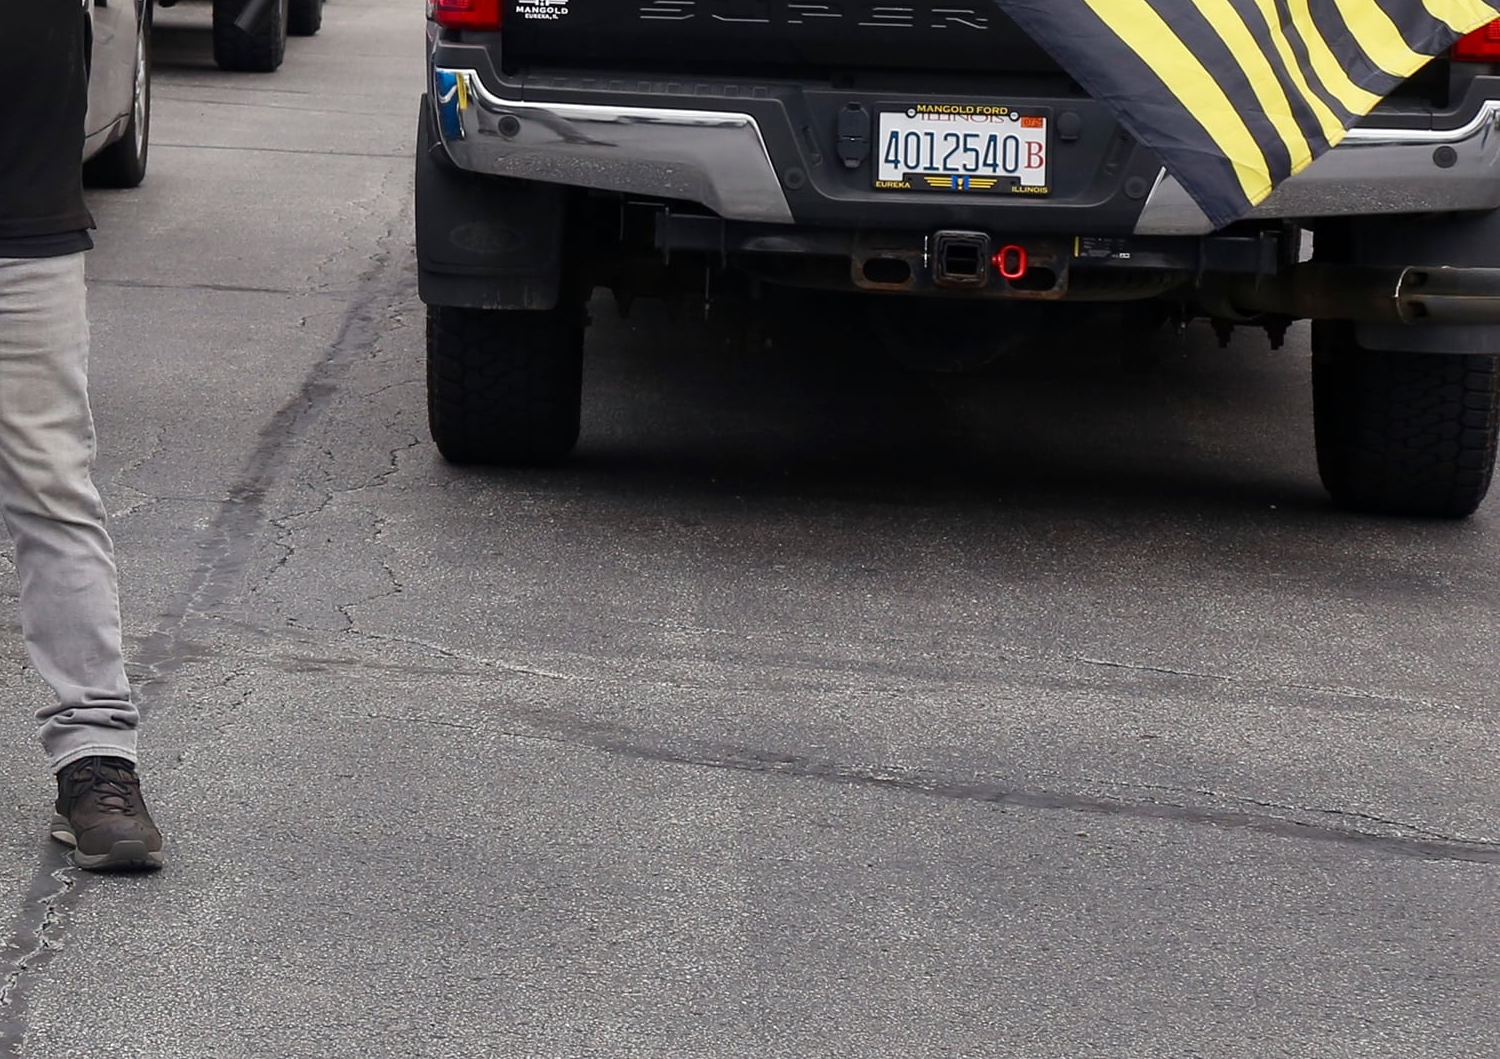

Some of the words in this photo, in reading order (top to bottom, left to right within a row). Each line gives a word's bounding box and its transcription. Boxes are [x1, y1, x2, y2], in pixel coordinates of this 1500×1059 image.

[515, 5, 569, 15] MANGOLD
[916, 104, 974, 114] MANGOLD
[976, 106, 1009, 116] FORD
[884, 130, 1020, 173] 4012540
[1023, 141, 1045, 169] B
[875, 180, 911, 189] EUREKA
[1011, 186, 1048, 194] ILLINOIS
